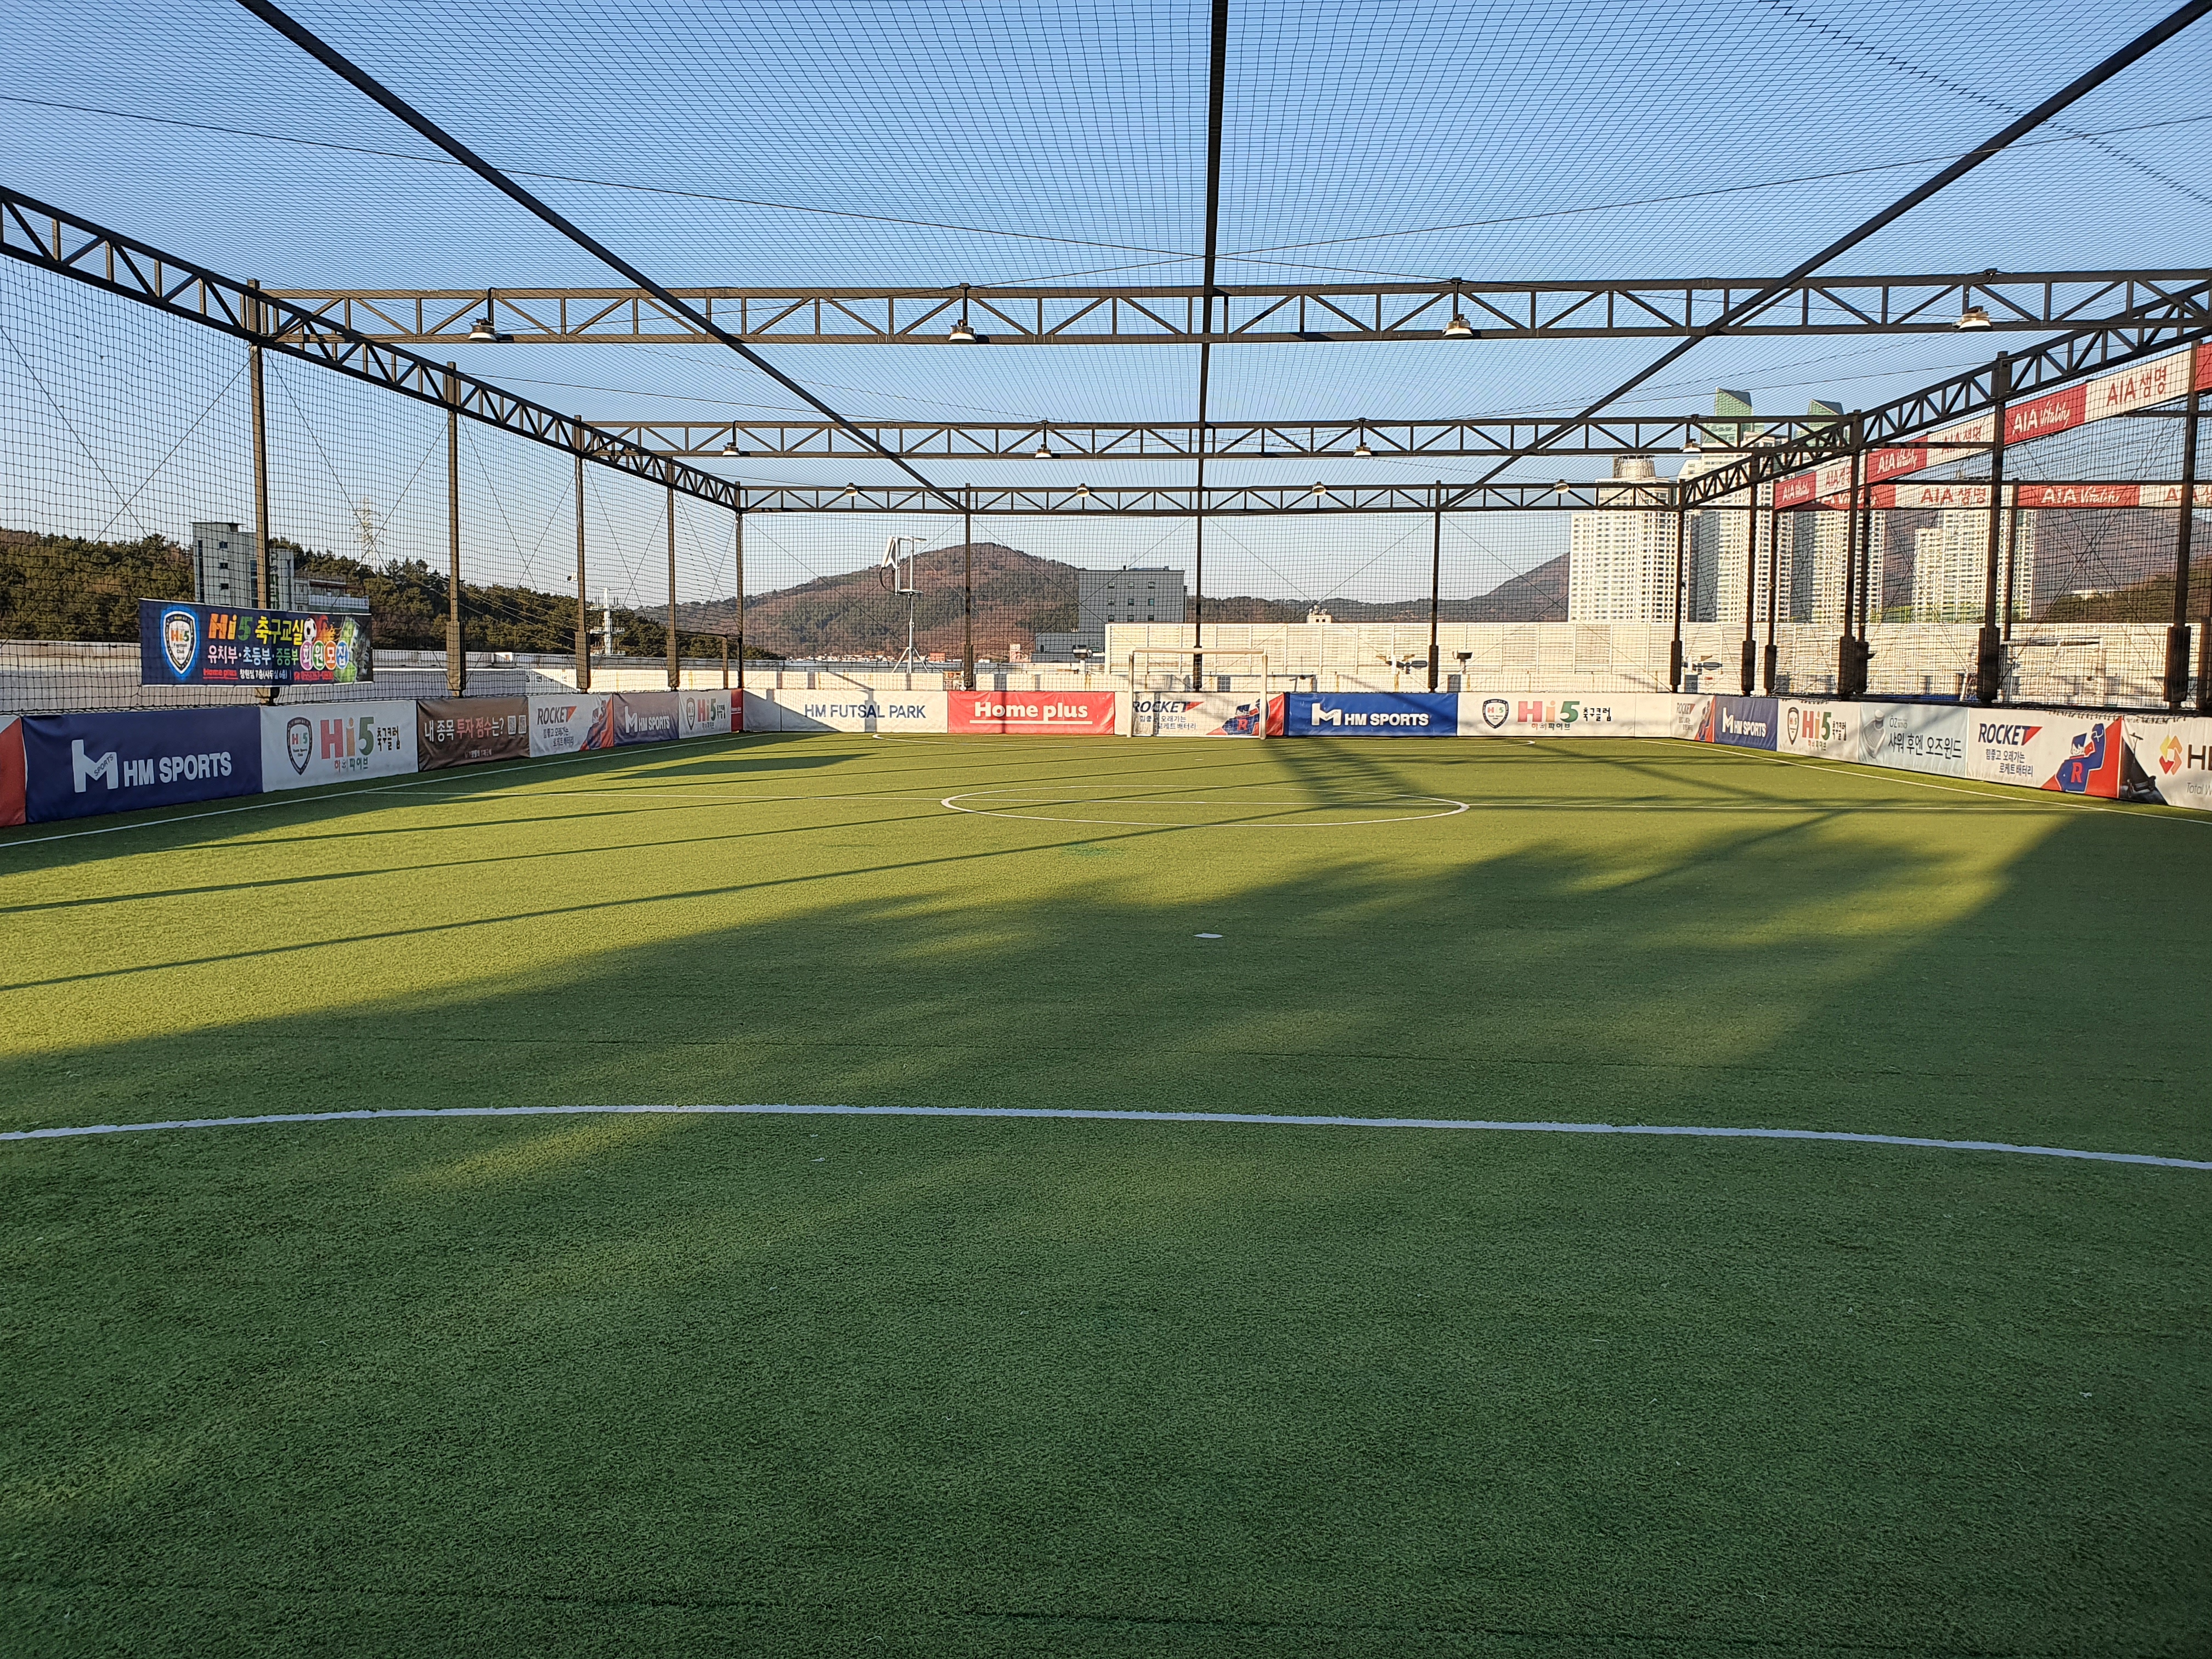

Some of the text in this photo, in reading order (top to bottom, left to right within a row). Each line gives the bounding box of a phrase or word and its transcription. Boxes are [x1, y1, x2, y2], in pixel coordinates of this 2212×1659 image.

[2107, 365, 2166, 407] AIA 생명
[2012, 400, 2070, 435] AIA Vitality
[1877, 448, 1917, 474] AIA Vitality
[1782, 484, 1795, 502] AIA
[1921, 487, 1987, 504] AIA 생명
[2041, 487, 2120, 504] AIA Vitality
[171, 630, 189, 642] Hi5
[208, 613, 304, 645] Hi5 축구교실
[303, 645, 347, 668] 회원모집
[537, 706, 577, 725] ROCKET
[697, 698, 716, 722] Hi5
[805, 704, 927, 719] HM FUTSAL PARK
[975, 701, 1088, 720] Home plus
[1133, 701, 1205, 713] ROCKET
[1517, 701, 1580, 723] Hi5
[1677, 703, 1696, 715] ROCKET
[425, 716, 504, 742] 내 종목 투자 점수는?
[639, 715, 670, 731] HM SPORTS
[1345, 713, 1429, 726] HM SPORTS
[1734, 720, 1767, 738] HM SPORTS
[1802, 710, 1832, 741] Hi5
[292, 732, 308, 745] H5
[320, 716, 374, 759] Hi5
[1978, 723, 2043, 746] ROCKET
[1888, 732, 1962, 759] 샤워 후엔 오즈윈드
[94, 754, 114, 777] SPORTS
[1986, 749, 2025, 763] 힘좋고 오래가는
[123, 752, 232, 787] HM SPORTS
[1999, 763, 2016, 775] 로케트
[2071, 762, 2083, 783] R
[2187, 782, 2204, 795] Total
